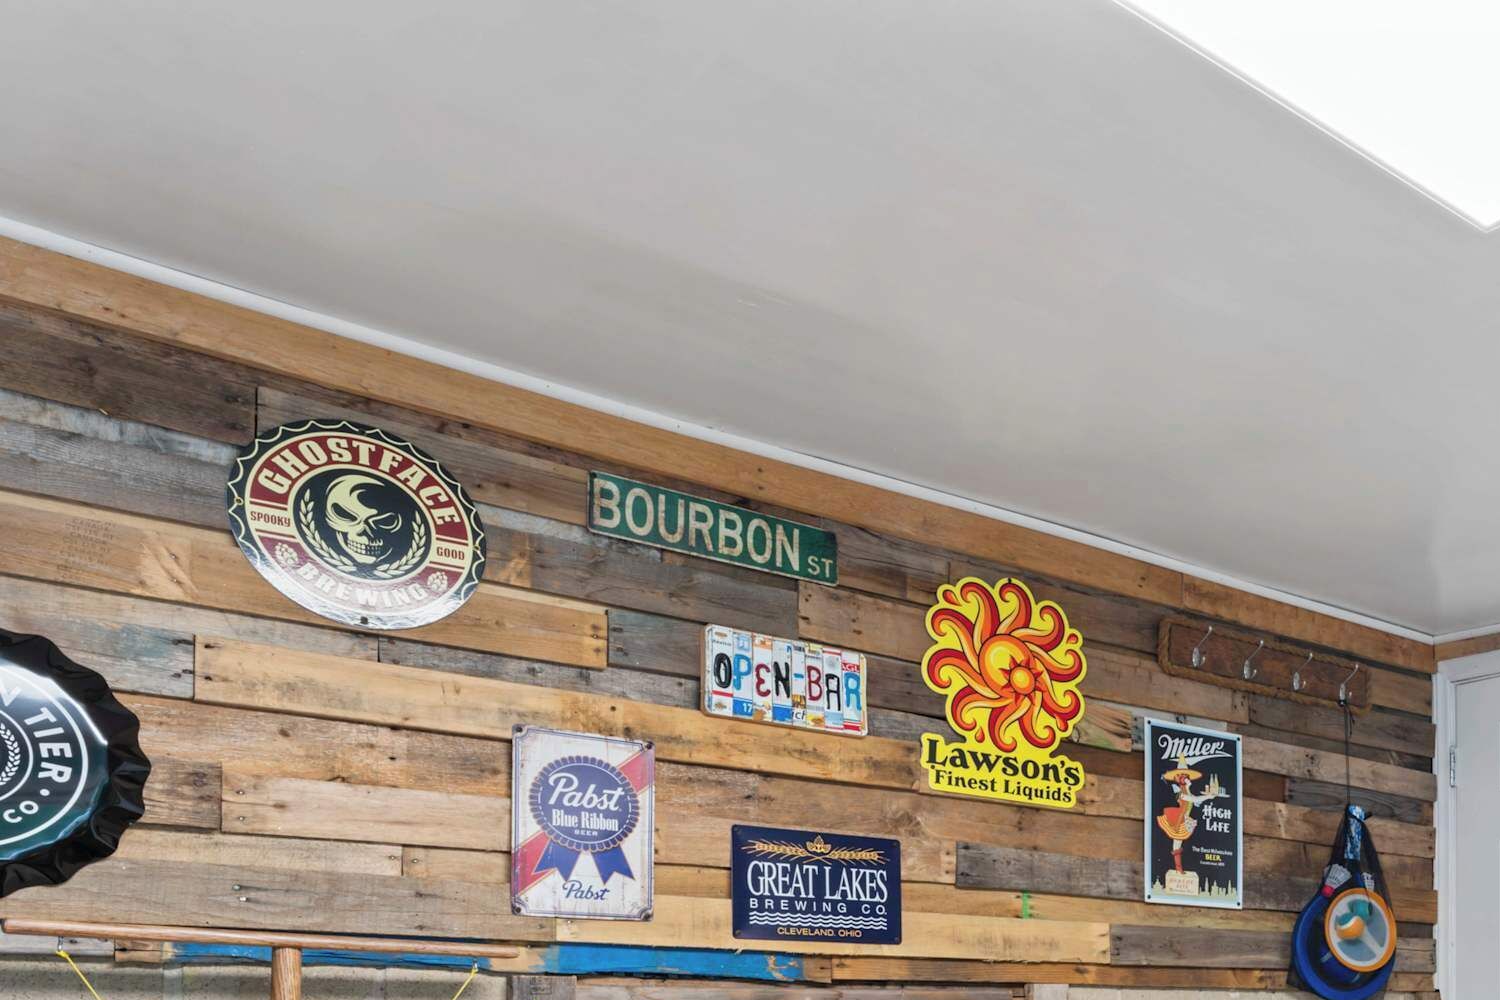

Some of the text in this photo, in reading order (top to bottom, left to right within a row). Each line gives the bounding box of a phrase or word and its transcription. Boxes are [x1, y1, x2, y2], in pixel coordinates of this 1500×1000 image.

[257, 436, 463, 527] GHOSTFACE
[250, 510, 291, 527] SPOOKY
[592, 478, 833, 578] BOURBON ST
[436, 546, 465, 561] GOOD
[297, 562, 428, 607] BREWING
[24, 707, 73, 784] TIER
[1158, 734, 1232, 766] Miller
[548, 772, 624, 811] Pabst
[934, 769, 1072, 803] Finest Liquids
[552, 809, 619, 831] Blue Ribbon
[574, 829, 598, 837] BEER
[563, 880, 610, 900] Pabst
[747, 860, 888, 903] GREAT LAKES
[750, 898, 847, 913] BREWING
[839, 929, 862, 938] OHIO
